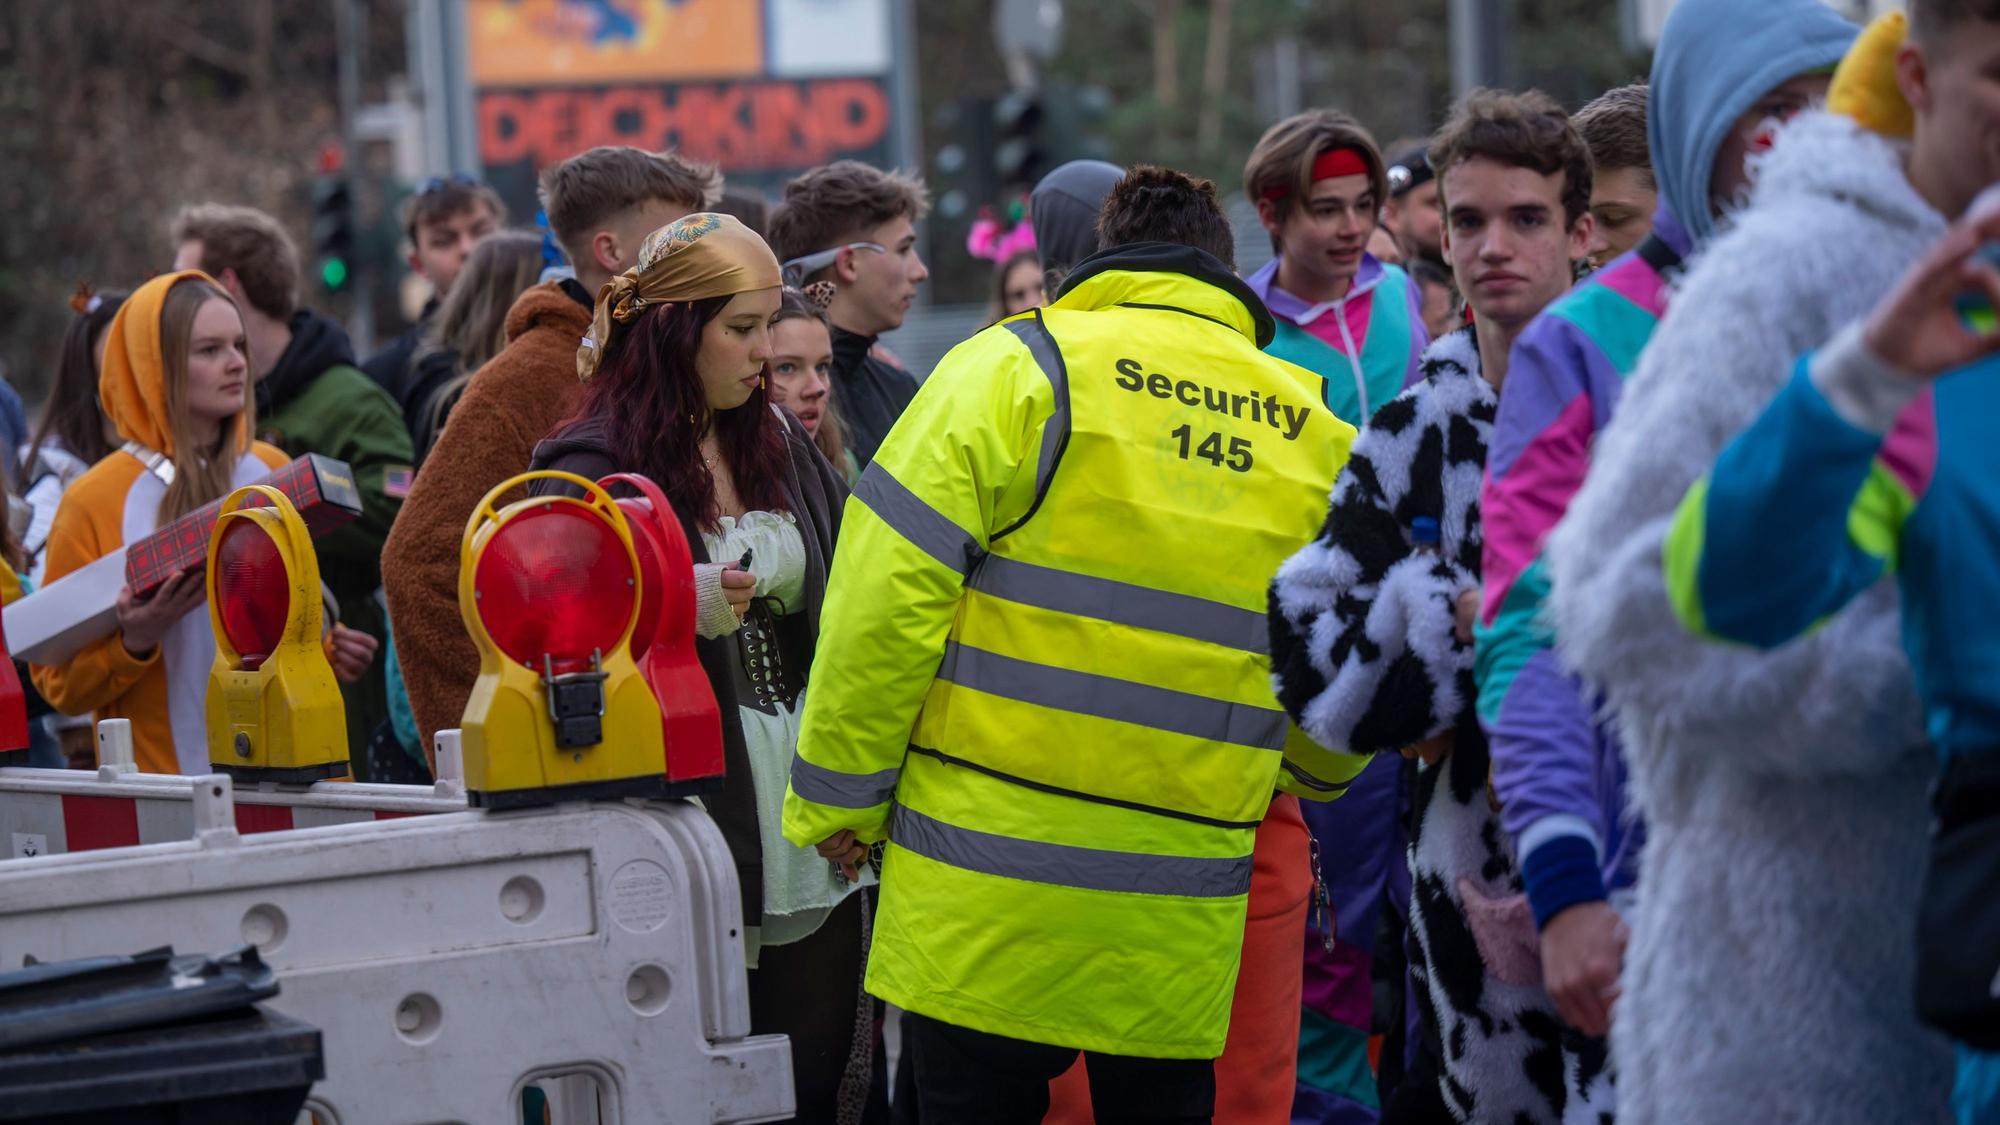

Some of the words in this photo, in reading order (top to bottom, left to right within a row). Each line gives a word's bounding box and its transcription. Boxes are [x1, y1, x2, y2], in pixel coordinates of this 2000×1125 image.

[480, 79, 888, 169] DEICHKIND
[1115, 358, 1312, 441] Security
[1171, 424, 1254, 473] 145
